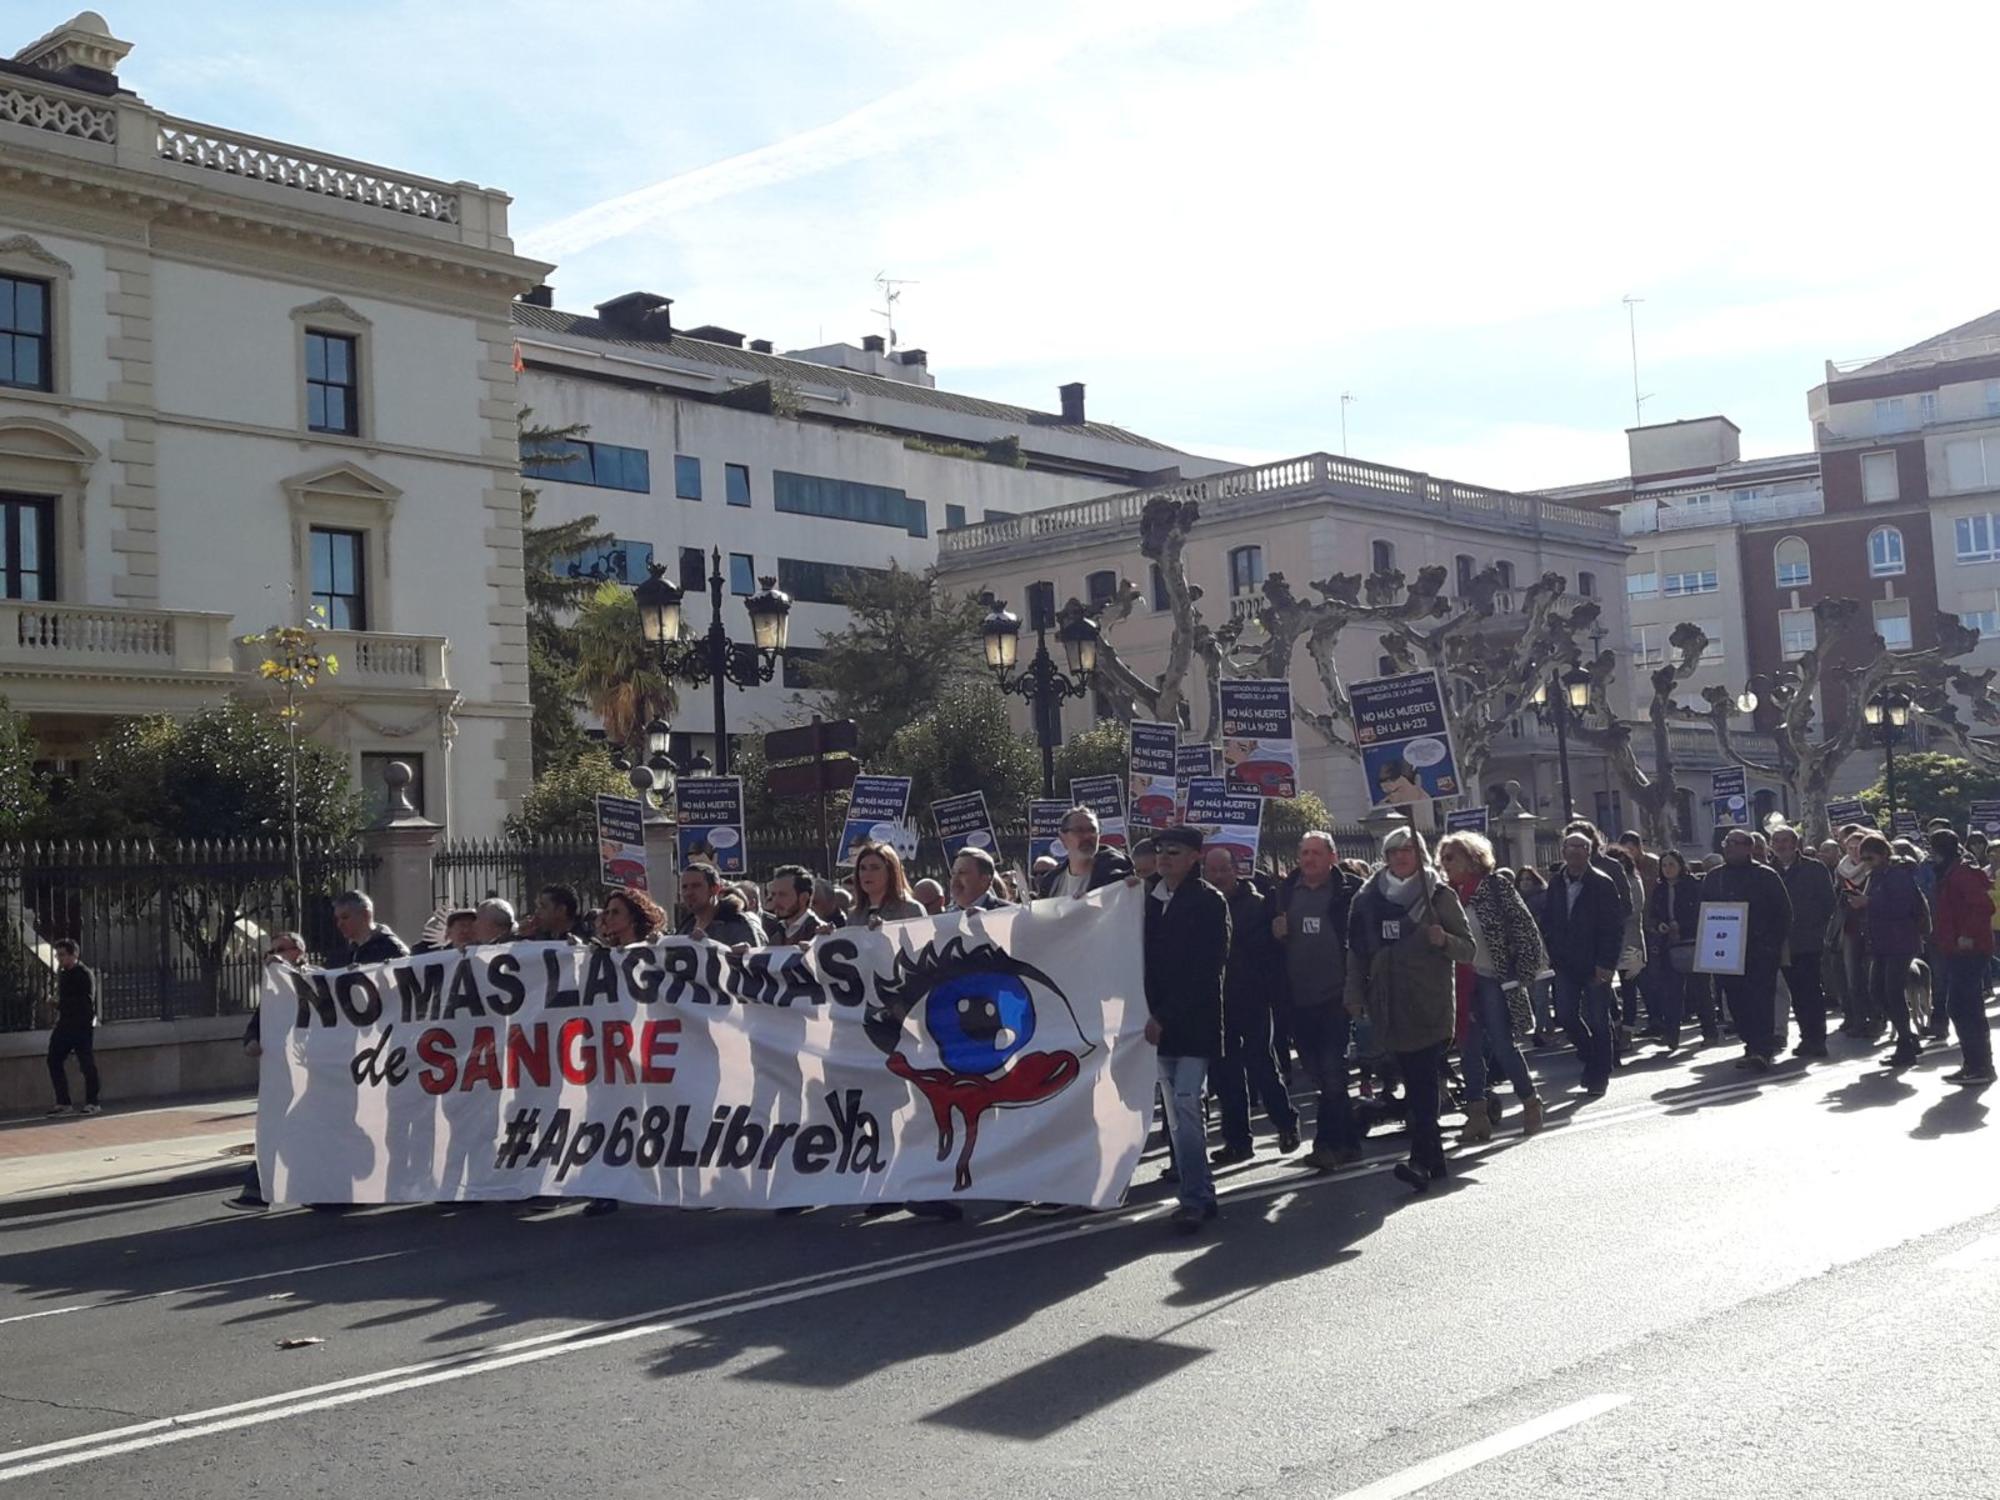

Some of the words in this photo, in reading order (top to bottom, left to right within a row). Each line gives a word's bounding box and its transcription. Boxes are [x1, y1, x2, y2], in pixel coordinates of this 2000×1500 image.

[1227, 708, 1238, 717] NO
[1240, 707, 1254, 718] MÁS
[1254, 709, 1287, 719] MUERTES
[1362, 712, 1376, 722] NO
[1377, 708, 1395, 720] MÁS
[1397, 702, 1436, 716] MUERTES
[1249, 722, 1257, 731] LA
[1376, 724, 1389, 735] EN
[1390, 722, 1402, 732] LA
[1402, 718, 1428, 730] N-232
[682, 801, 691, 809] NO
[707, 800, 737, 809] MUERTES
[1206, 798, 1221, 808] MÁS
[1223, 801, 1257, 810] MUERTES
[1224, 811, 1246, 820] N-232
[291, 971, 383, 1028] NO
[394, 953, 525, 1023] MAS
[542, 938, 865, 1009] LAGRIMAS
[351, 1023, 409, 1087] de
[417, 1017, 681, 1095] SANGRE
[493, 1089, 886, 1182] #Ap68LibreYa
